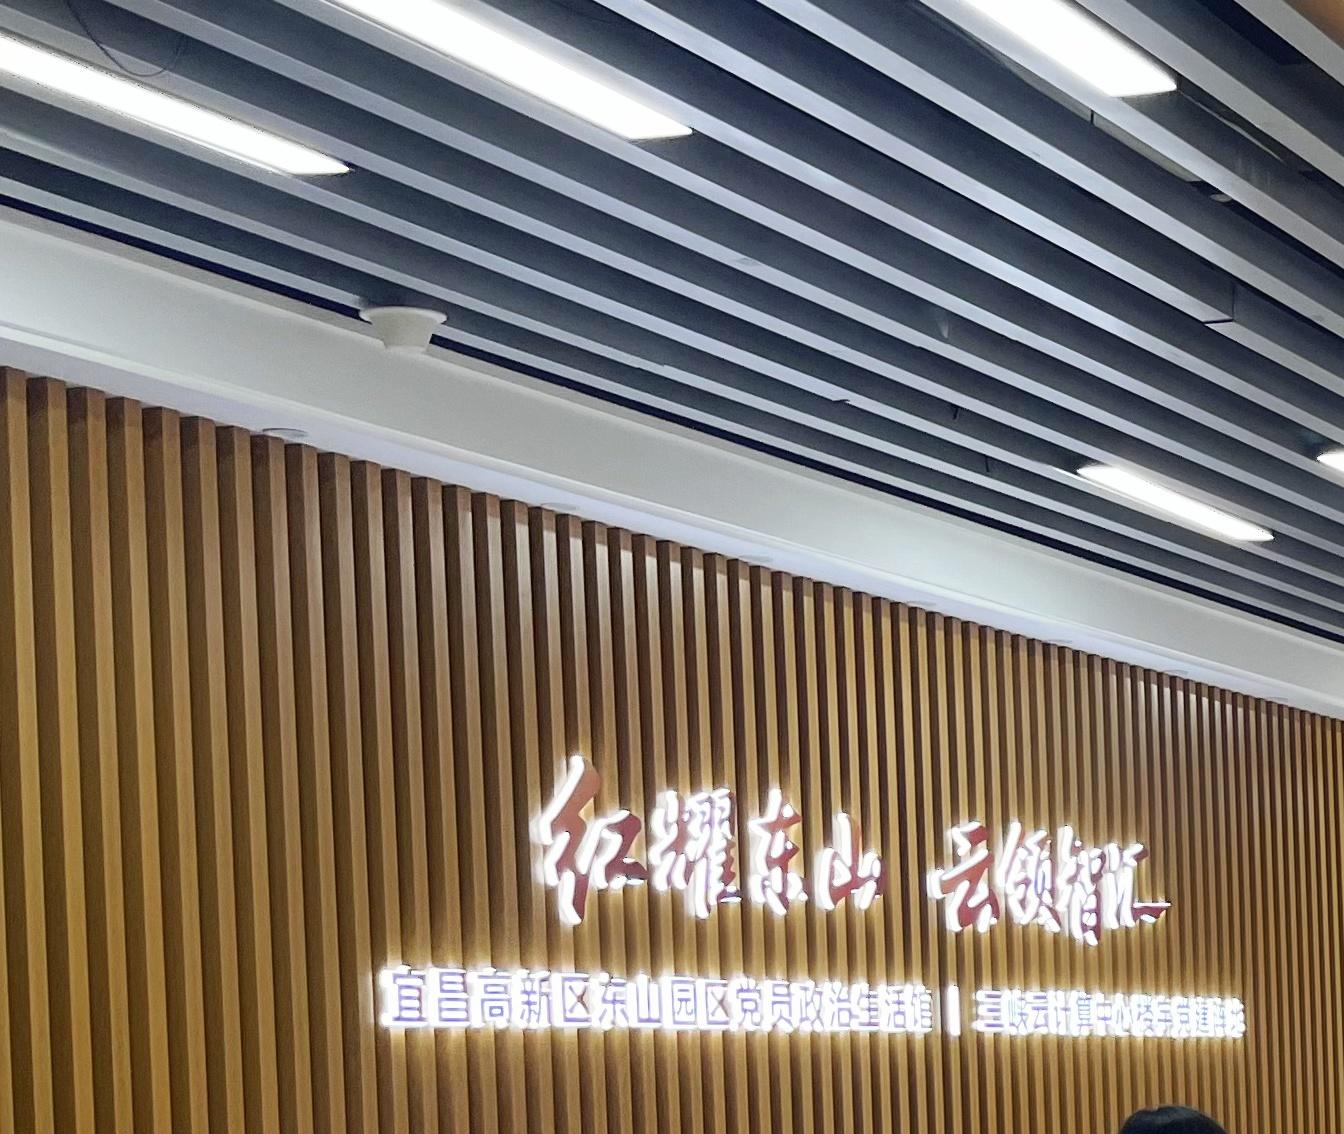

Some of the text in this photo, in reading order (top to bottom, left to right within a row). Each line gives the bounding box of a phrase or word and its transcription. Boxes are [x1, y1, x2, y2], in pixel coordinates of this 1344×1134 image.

[381, 965, 934, 1034] 宜昌高新区东山园区党员政治生活馆
